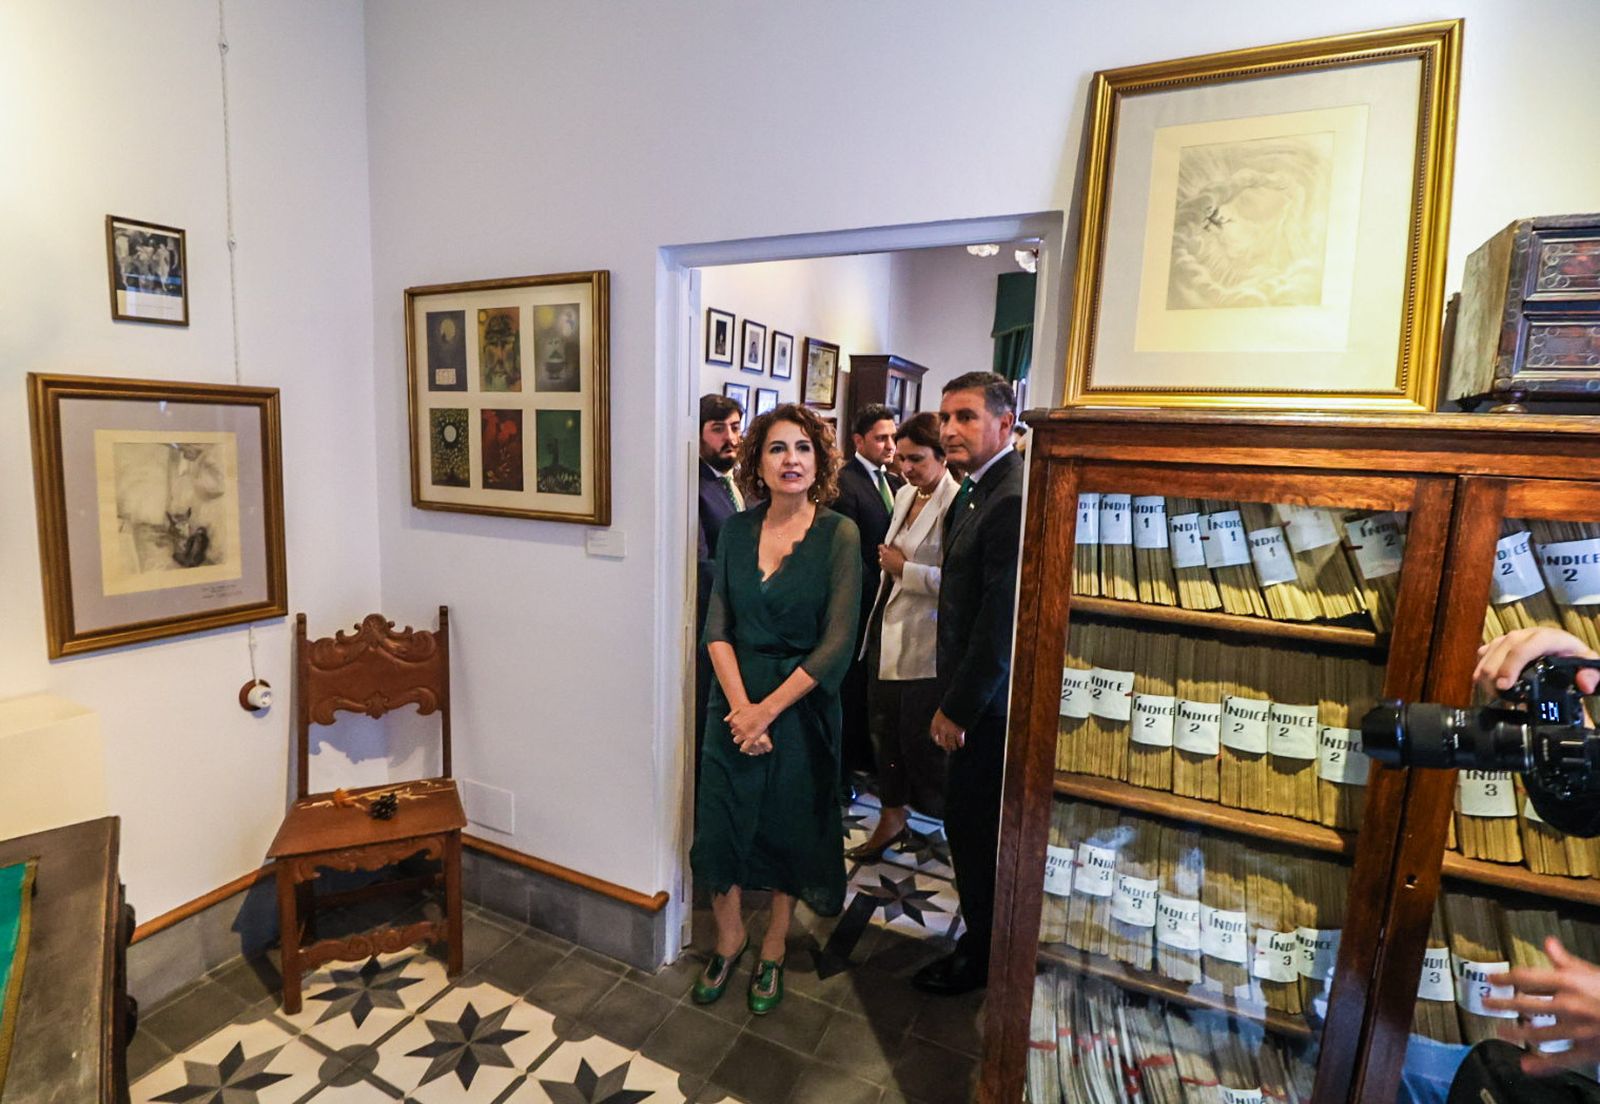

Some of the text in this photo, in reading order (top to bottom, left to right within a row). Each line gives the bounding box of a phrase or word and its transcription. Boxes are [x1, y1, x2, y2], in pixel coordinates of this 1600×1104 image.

[1083, 513, 1088, 522] 1
[1115, 513, 1120, 522] 1
[1144, 517, 1149, 528] 1
[1189, 534, 1195, 543] 1
[1231, 531, 1236, 541] 1
[1384, 534, 1395, 547] 2
[1269, 547, 1275, 557] 1
[1502, 563, 1514, 575] 2
[1563, 568, 1578, 582] 2
[1061, 690, 1073, 701] 2
[1093, 688, 1102, 699] 2
[1133, 695, 1175, 716] ÍNDICE
[1224, 697, 1268, 722] ÍNDICE
[1177, 701, 1220, 723] ÍNDICE
[1144, 717, 1156, 728] 2
[1189, 723, 1200, 733] 2
[1233, 723, 1244, 733] 2
[1279, 727, 1290, 737] 2
[1330, 752, 1341, 763] 2
[1484, 784, 1498, 797] 3
[1046, 866, 1055, 878] 3
[1100, 871, 1109, 881] 3
[1132, 898, 1143, 909] 3
[1168, 919, 1178, 931] 3
[1221, 933, 1232, 943] 3
[1283, 956, 1292, 966] 3
[1304, 950, 1314, 961] 3
[1430, 972, 1441, 984] 3
[1479, 986, 1491, 998] 3
